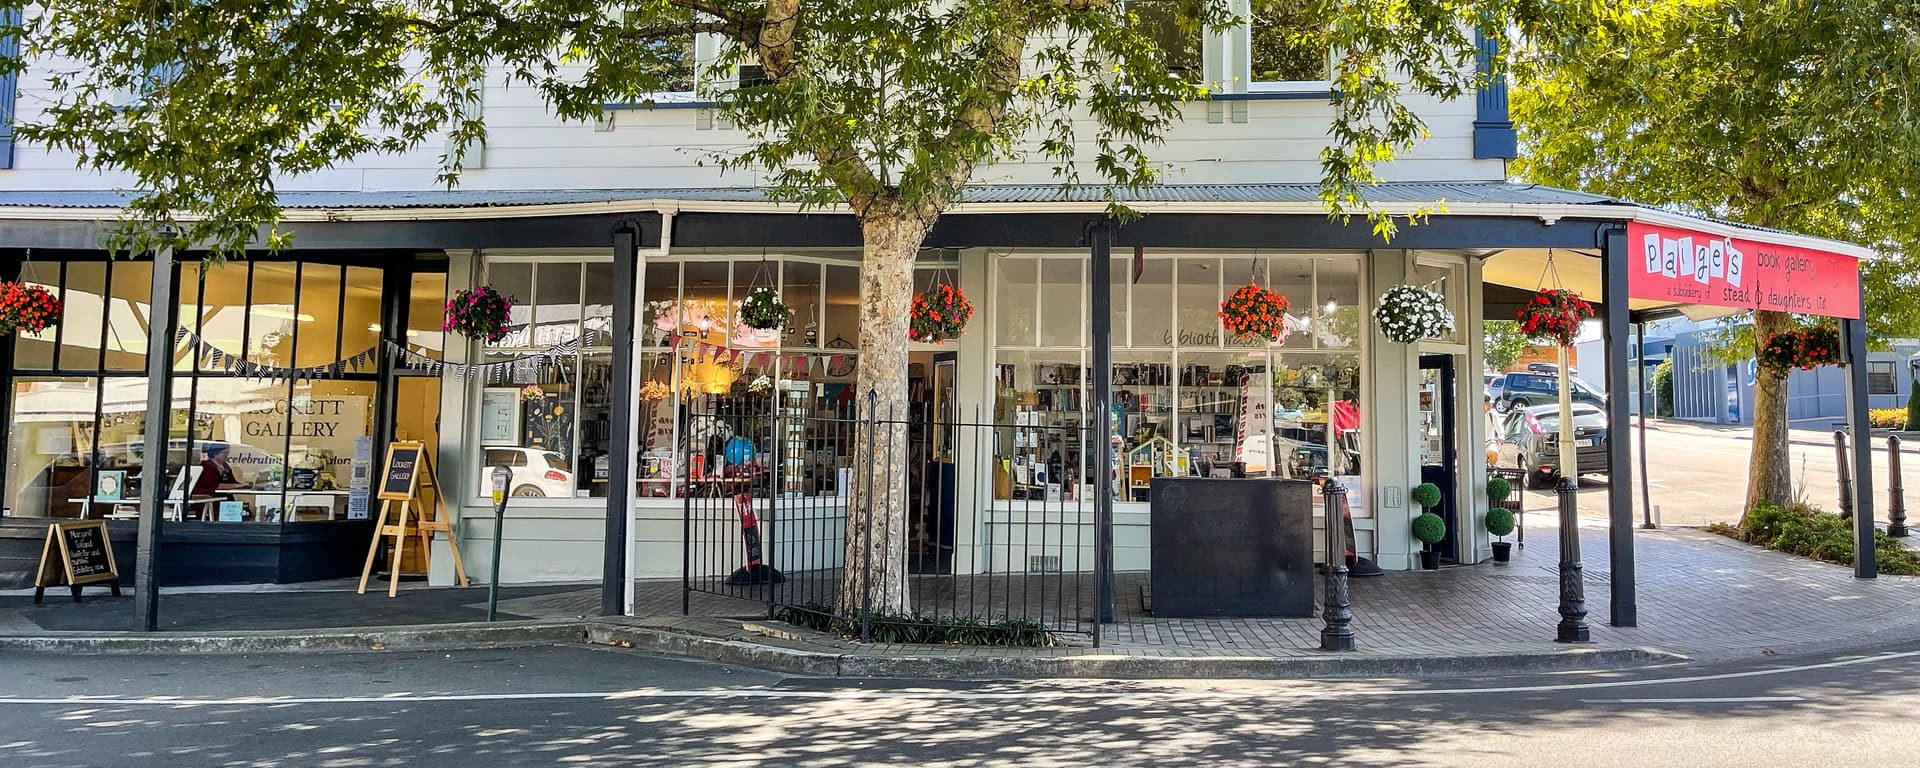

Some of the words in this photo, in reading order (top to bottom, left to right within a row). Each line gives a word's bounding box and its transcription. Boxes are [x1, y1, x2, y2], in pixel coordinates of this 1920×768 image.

[1647, 240, 1739, 280] paige's
[1757, 248, 1780, 268] book
[1785, 256, 1815, 282] gallery
[1723, 283, 1751, 303] stead
[1768, 288, 1812, 311] daughters
[246, 420, 340, 437] GALLERY
